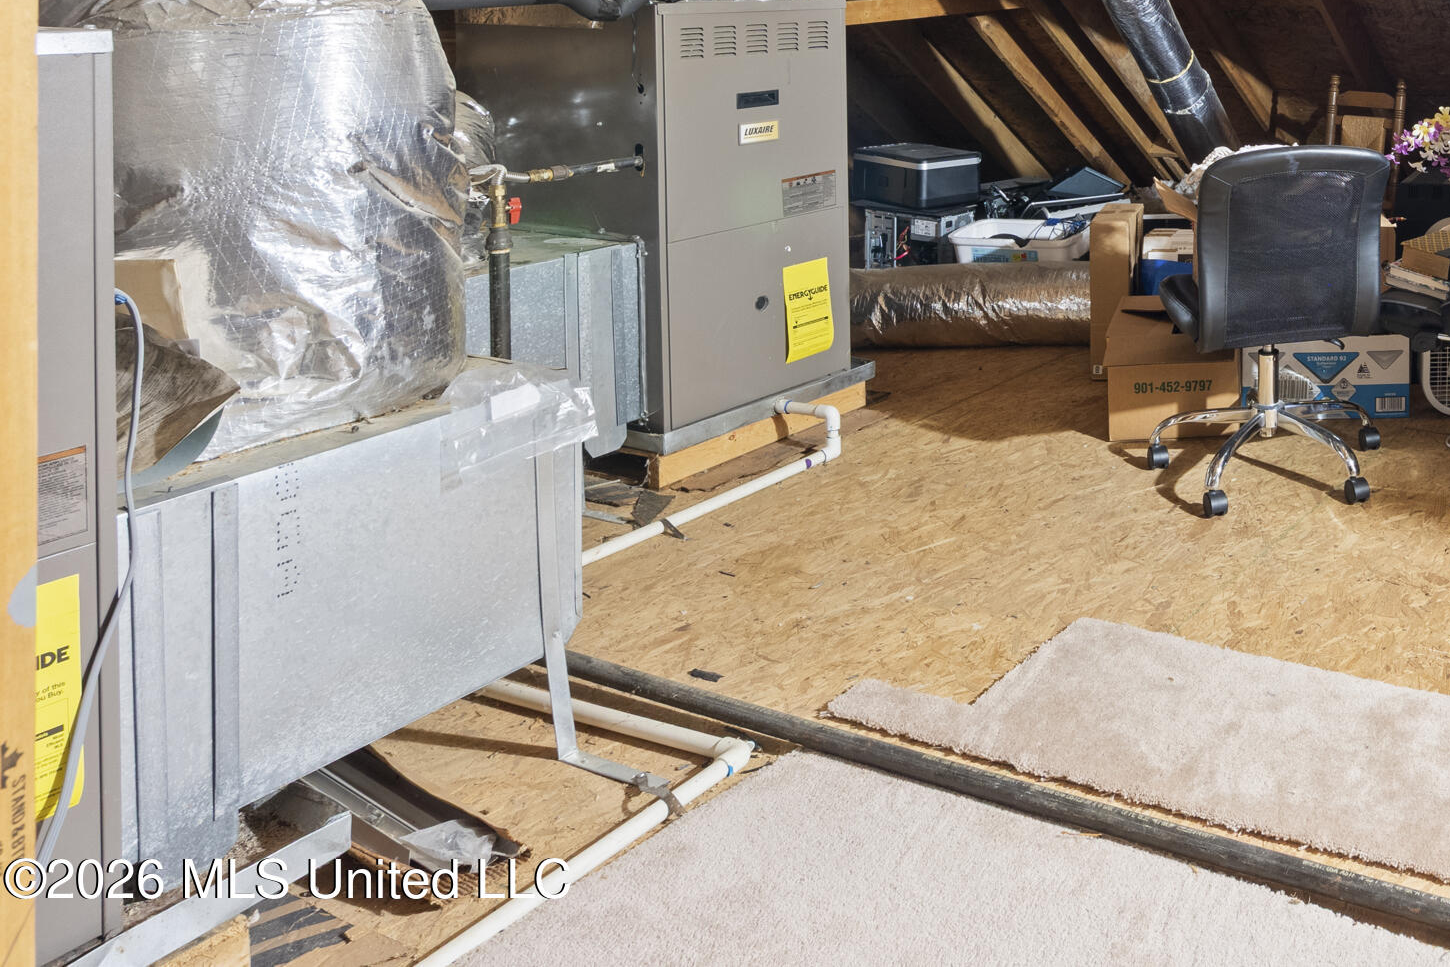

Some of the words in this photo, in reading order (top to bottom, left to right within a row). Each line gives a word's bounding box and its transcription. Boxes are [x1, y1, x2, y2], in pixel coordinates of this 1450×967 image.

[744, 124, 774, 136] LUXAIRE
[788, 284, 828, 300] ENERGYGUIDE
[1134, 380, 1212, 394] 901-452-9797
[36, 645, 70, 671] IDE
